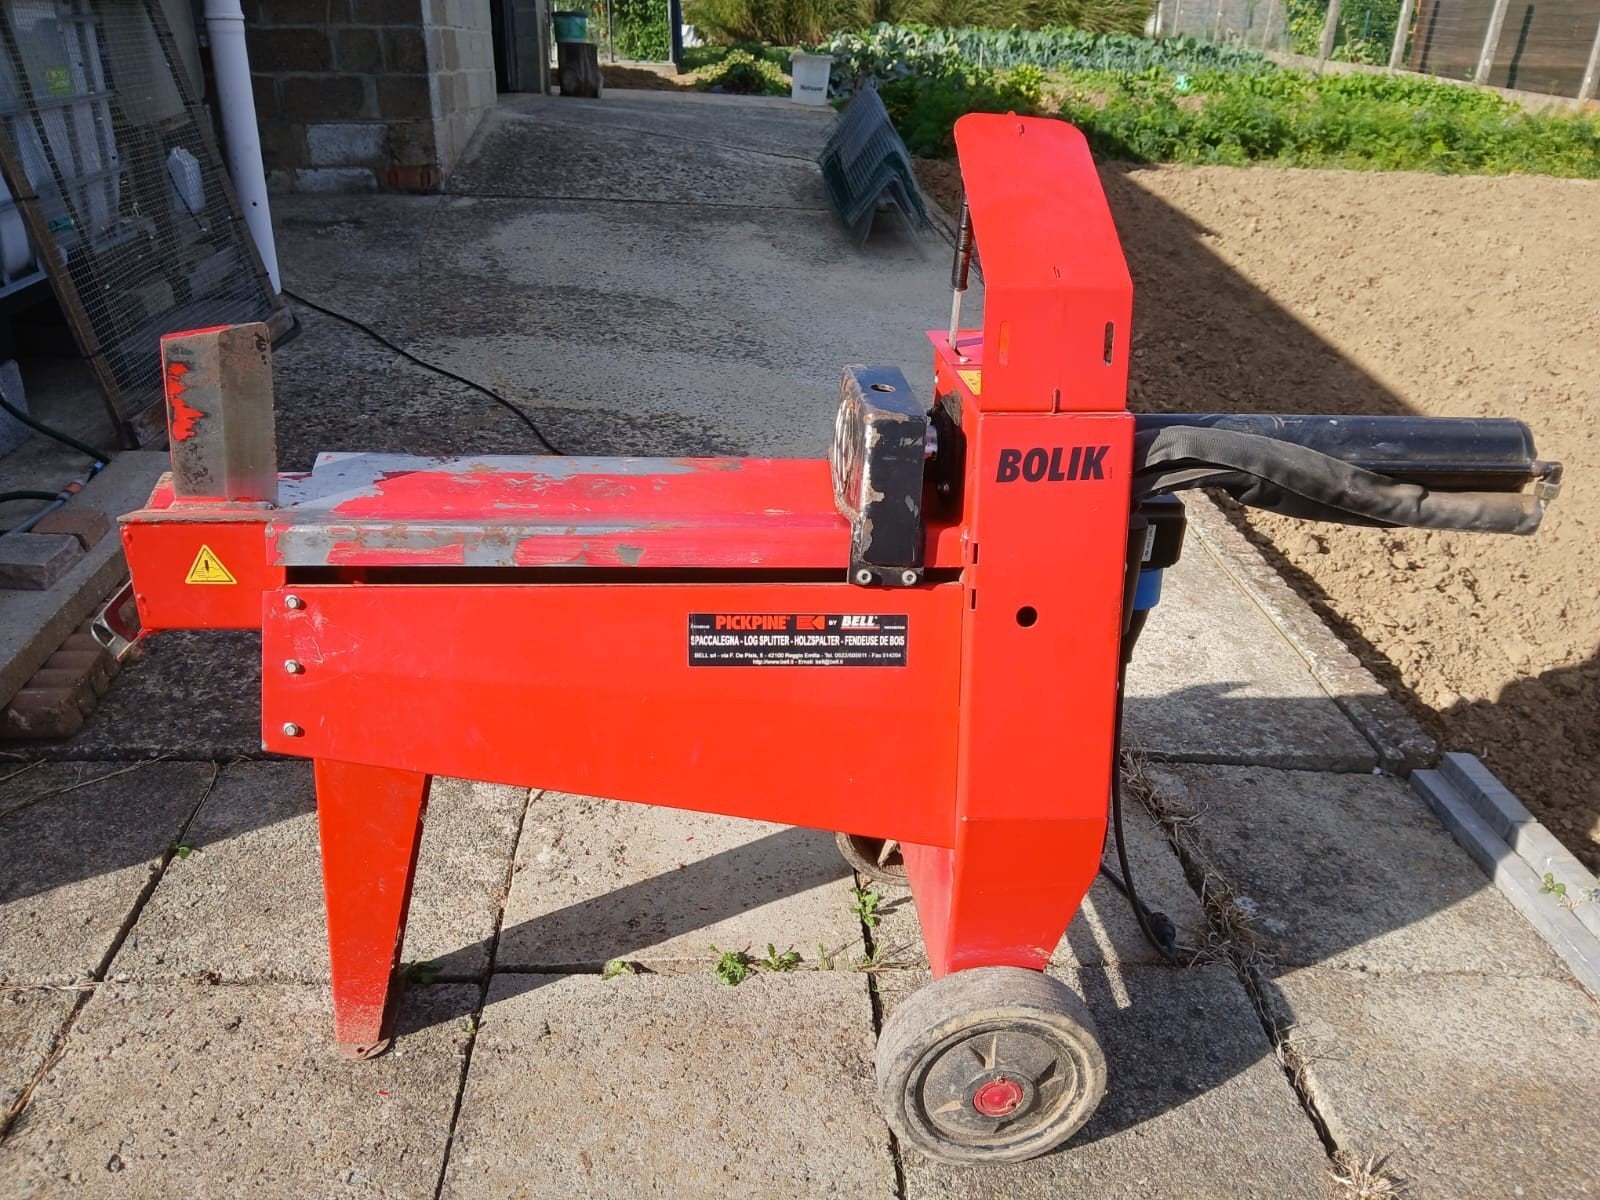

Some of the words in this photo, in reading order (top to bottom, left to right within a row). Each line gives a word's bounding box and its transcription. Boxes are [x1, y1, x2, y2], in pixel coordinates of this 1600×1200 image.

[996, 445, 1111, 482] BOLIK
[715, 615, 787, 630] PICKPINE
[841, 615, 876, 627] BELL
[690, 635, 740, 646] SPACCALEGNA
[744, 635, 759, 646] LOG
[759, 635, 790, 646] SPLITTER
[794, 635, 840, 646] HOLZSPALTER
[844, 635, 879, 646] FENDEUSE
[879, 635, 889, 646] DE
[889, 635, 905, 646] BOIS
